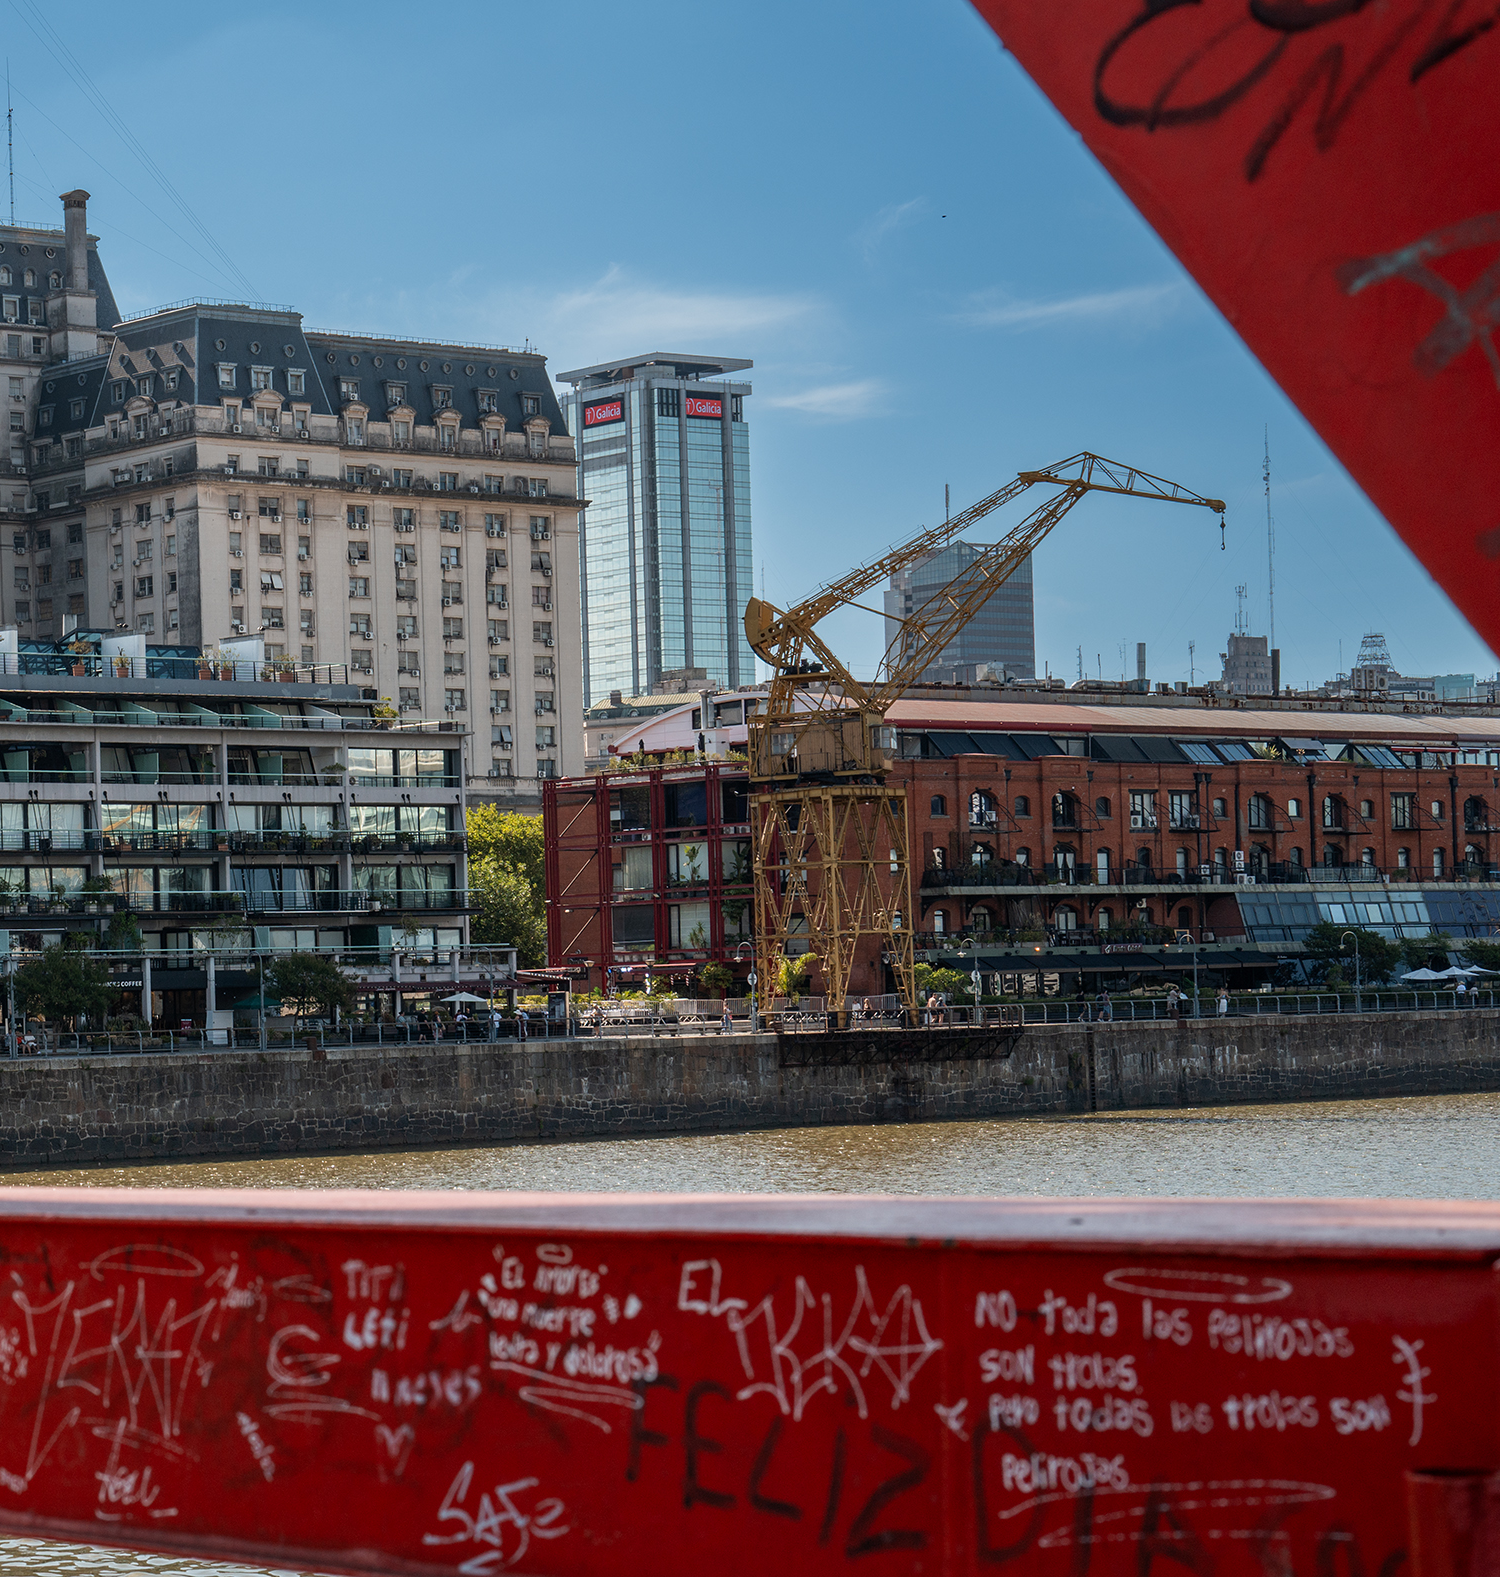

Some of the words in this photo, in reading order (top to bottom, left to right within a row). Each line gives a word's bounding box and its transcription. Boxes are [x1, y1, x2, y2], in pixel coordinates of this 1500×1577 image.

[596, 405, 621, 420] Galicia
[695, 401, 722, 415] Galicia
[120, 980, 143, 988] COFFEE
